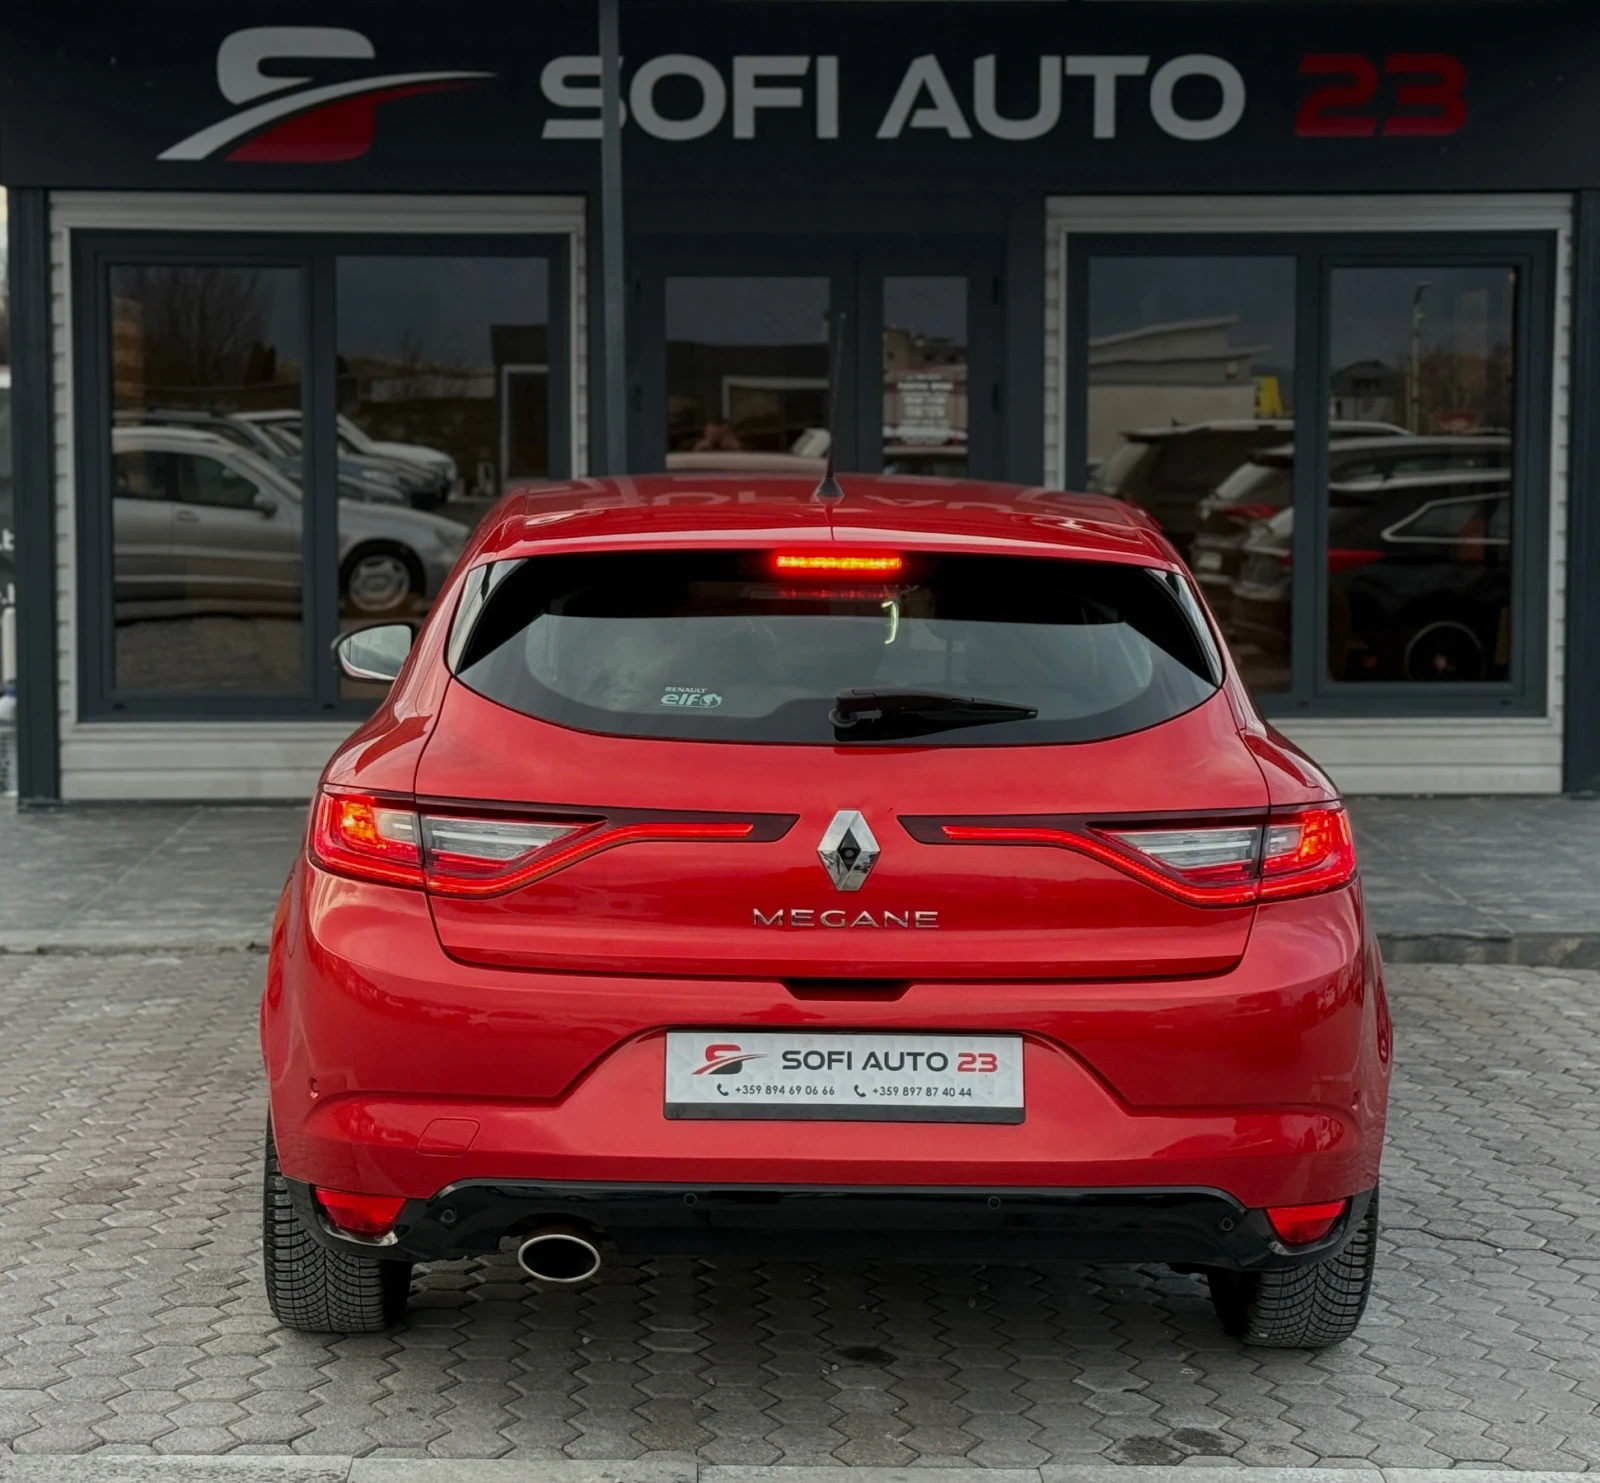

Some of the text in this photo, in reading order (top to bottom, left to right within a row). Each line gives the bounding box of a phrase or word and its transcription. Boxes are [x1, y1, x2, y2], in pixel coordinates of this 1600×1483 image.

[540, 53, 1468, 141] SOFI AUTO 23
[665, 686, 708, 694] RENAULT
[752, 908, 940, 929] MEGANE
[781, 1050, 998, 1073] SOFI AUTO 23
[735, 1085, 762, 1096] +359
[765, 1084, 785, 1096] 894
[789, 1085, 801, 1096] 69
[872, 1086, 973, 1099] +359 897 87 40 44
